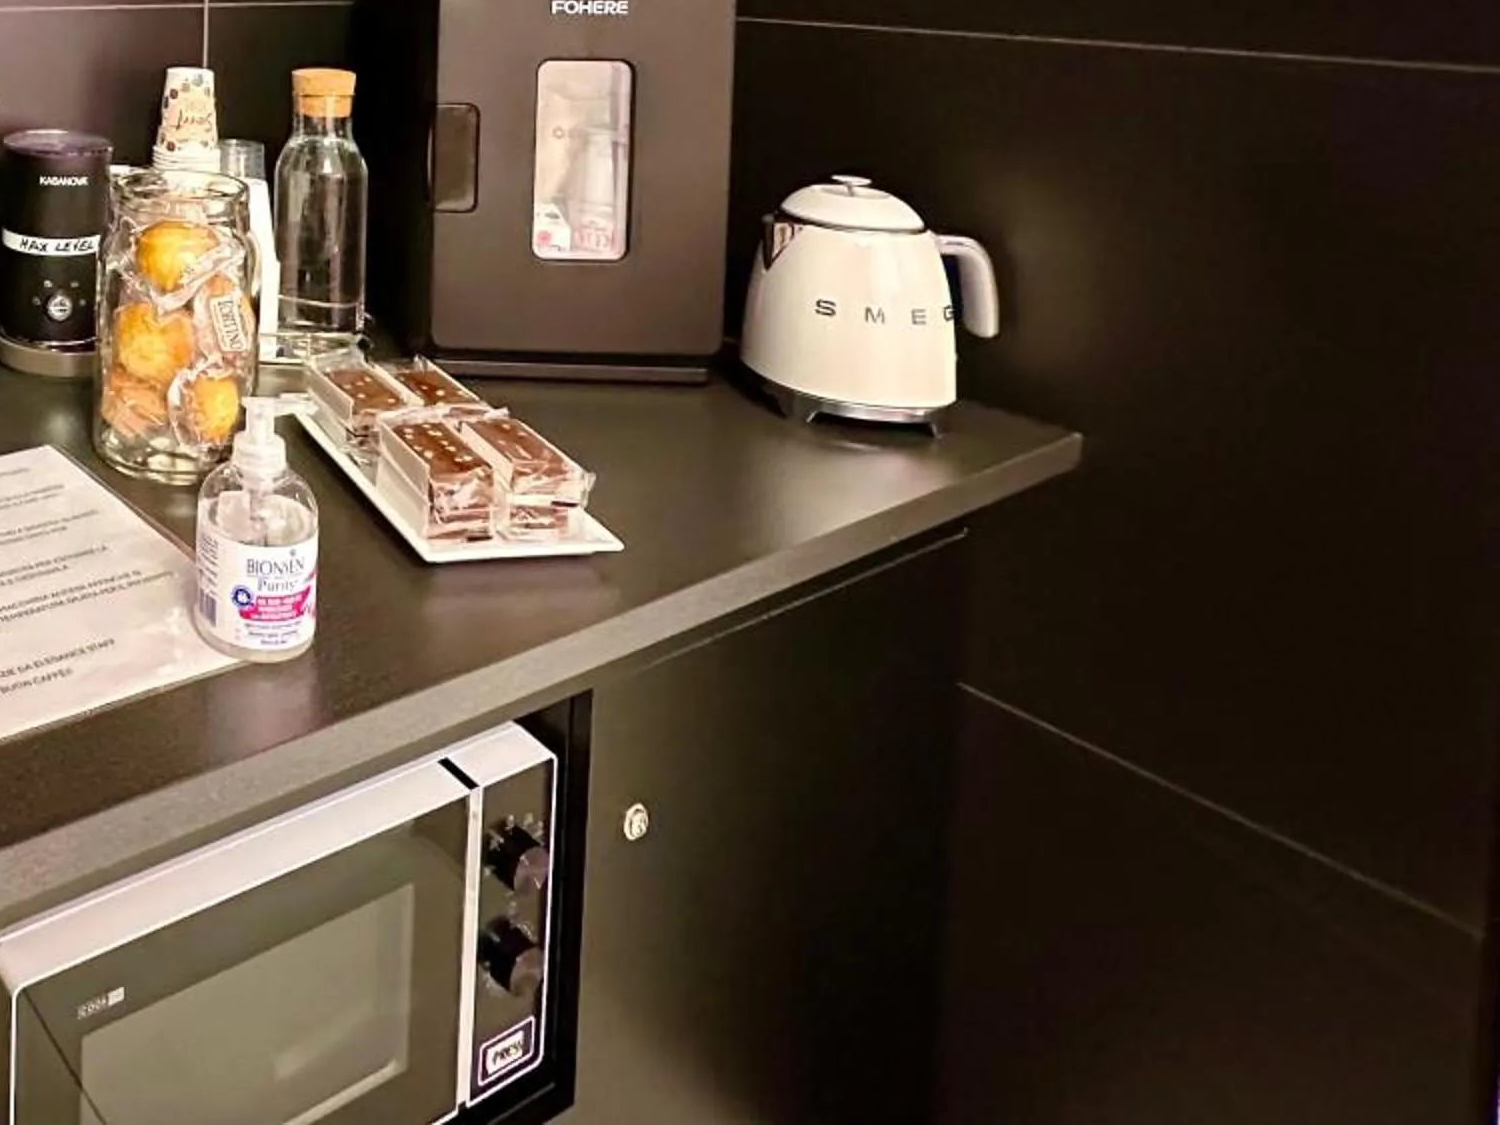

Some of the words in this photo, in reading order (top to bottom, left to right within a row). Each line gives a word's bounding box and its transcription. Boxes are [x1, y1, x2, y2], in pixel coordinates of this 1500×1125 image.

[552, 0, 629, 15] FOHERE
[20, 238, 48, 252] MAX
[55, 239, 95, 252] LEVEL
[814, 299, 956, 325] SMEG
